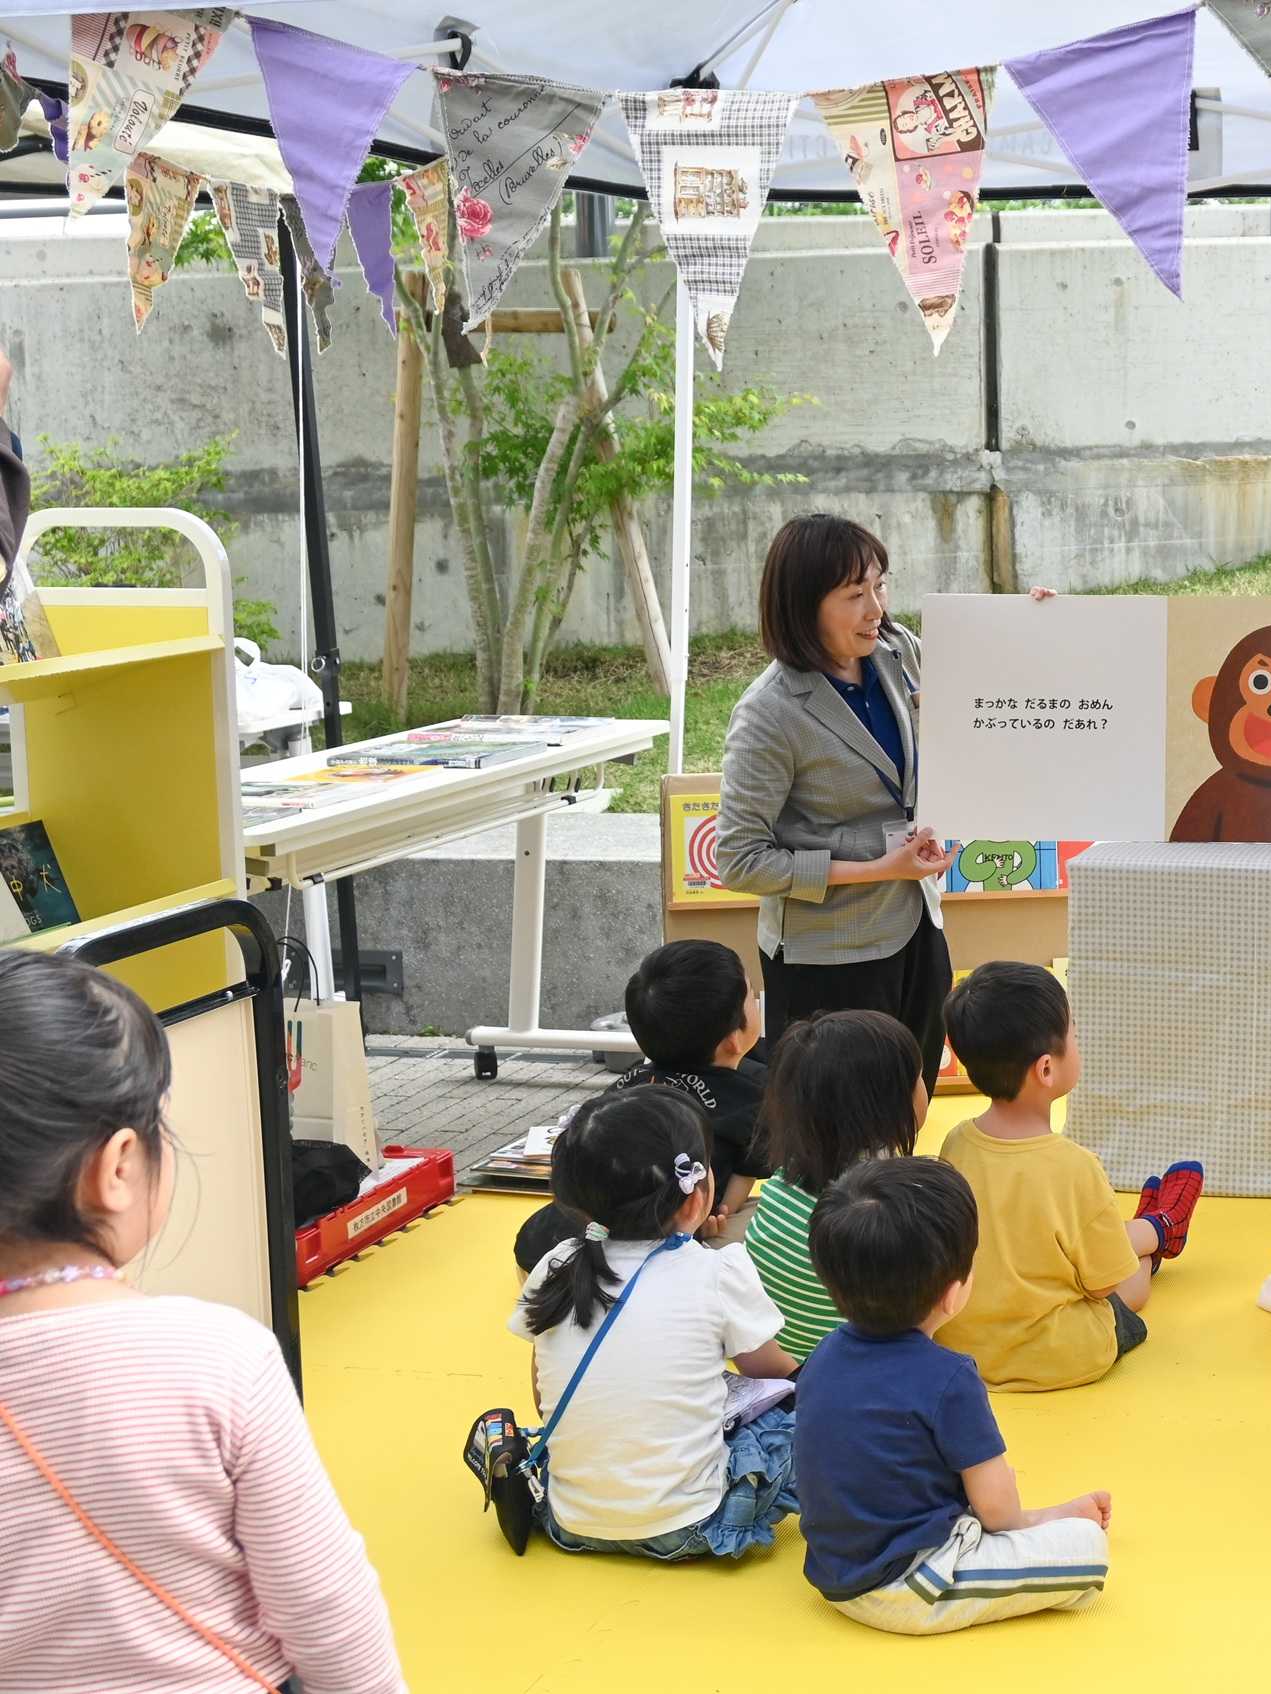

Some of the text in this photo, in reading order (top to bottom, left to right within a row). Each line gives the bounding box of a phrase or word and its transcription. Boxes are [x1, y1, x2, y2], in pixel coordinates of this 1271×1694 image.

[932, 73, 978, 142] CHARM
[912, 210, 938, 265] SOLEIL
[973, 697, 1114, 711] まっかな だるまの おめん
[973, 717, 1108, 731] かぶっているの だあれ？
